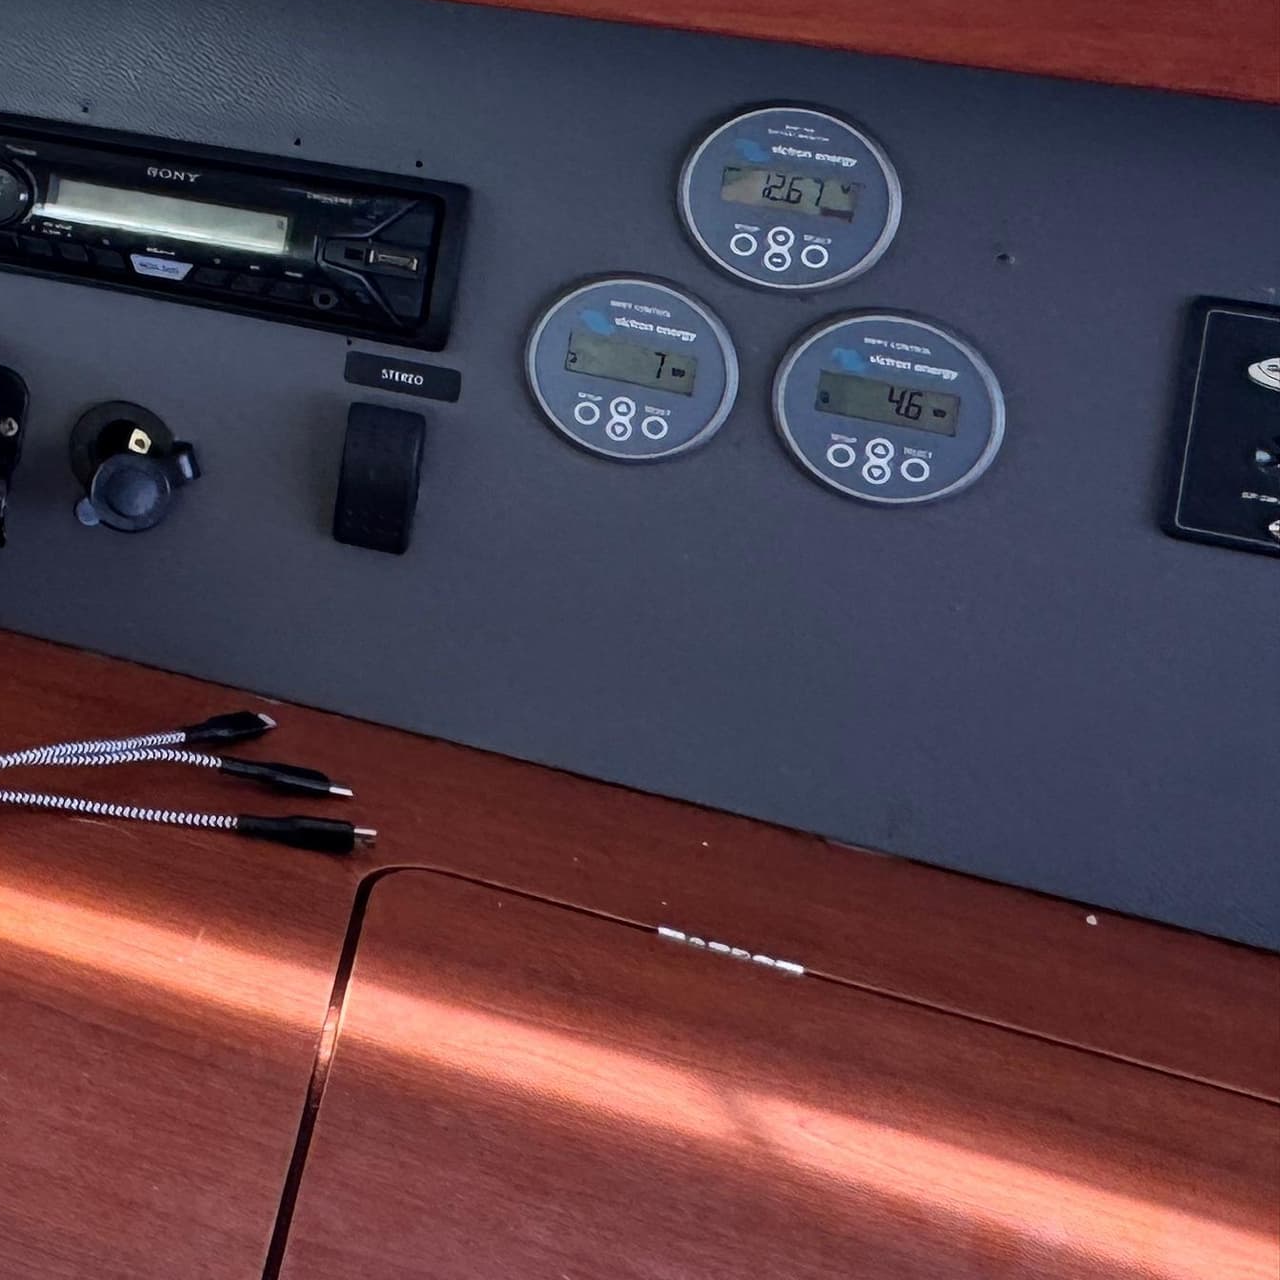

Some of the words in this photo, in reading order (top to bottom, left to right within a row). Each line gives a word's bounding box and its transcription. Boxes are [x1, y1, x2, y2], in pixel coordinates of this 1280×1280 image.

[815, 152, 858, 168] energy
[146, 166, 202, 183] SONY
[656, 325, 697, 342] energy
[381, 368, 425, 386] STEREO
[914, 364, 959, 381] energy
